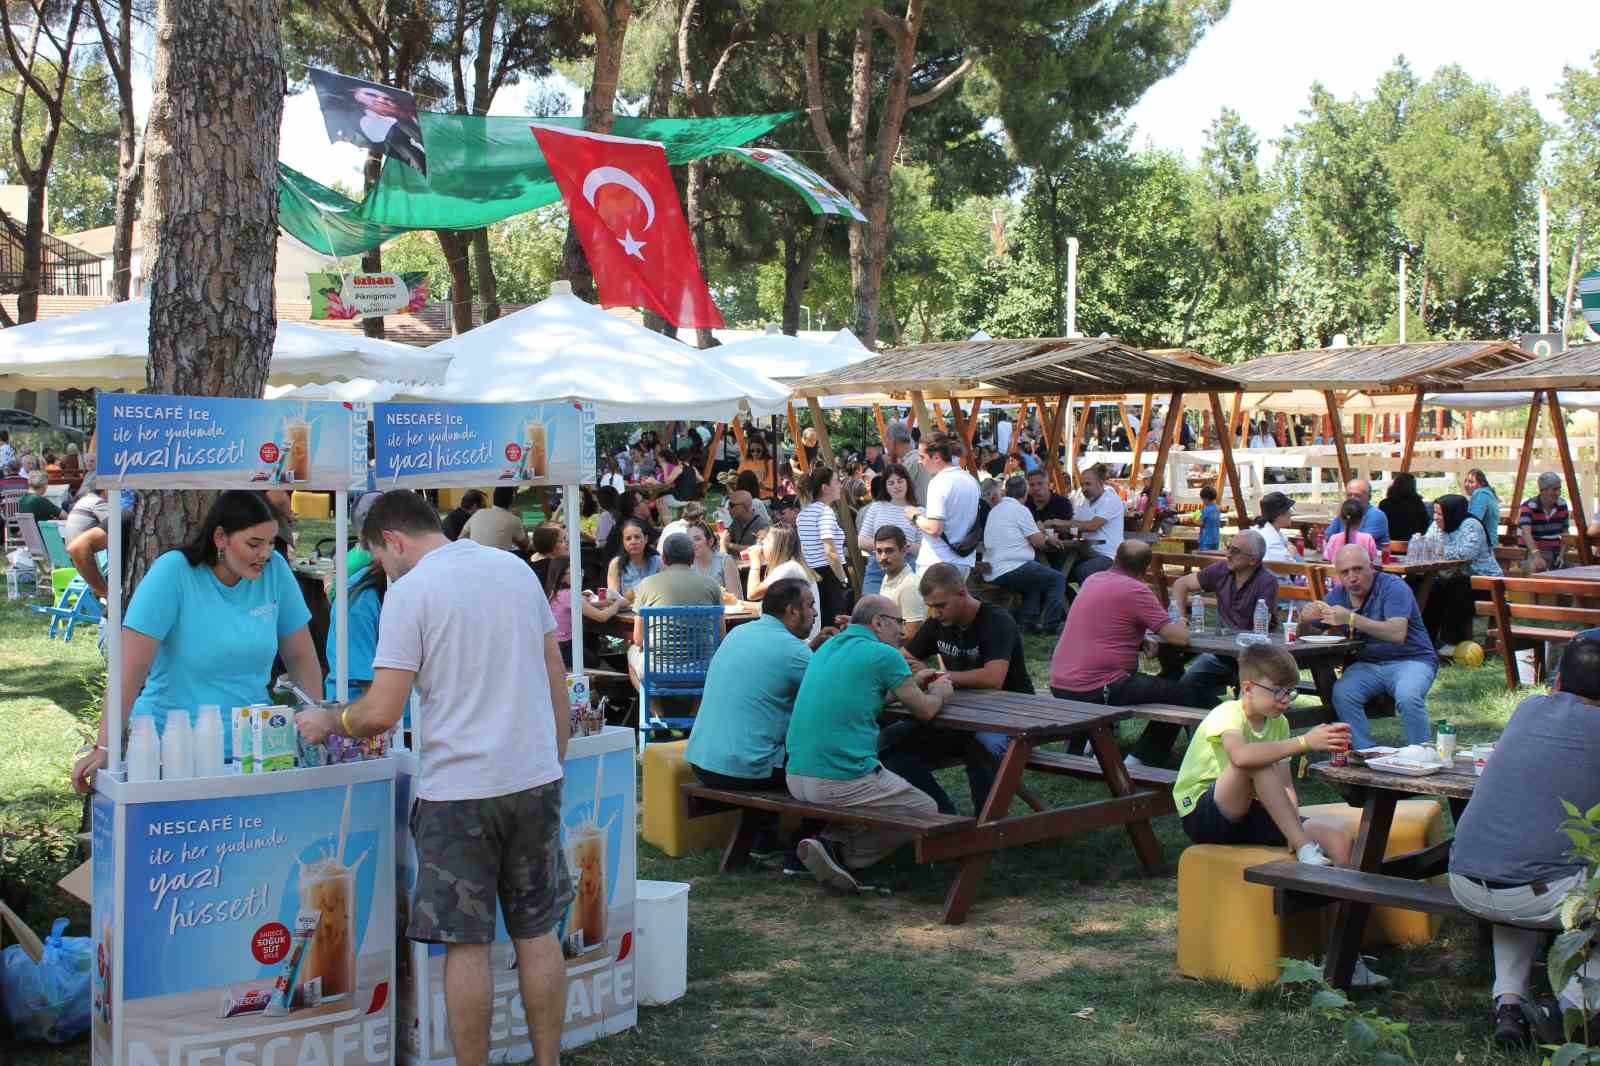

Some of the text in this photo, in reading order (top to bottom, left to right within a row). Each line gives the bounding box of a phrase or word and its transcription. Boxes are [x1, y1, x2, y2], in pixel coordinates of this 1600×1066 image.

[113, 405, 210, 421] NESCAFÉ Ice
[387, 412, 464, 425] NESCAFÉ Ice
[113, 420, 225, 445] ile her yudumda
[386, 424, 478, 449] ile her yudumda
[173, 439, 245, 470] hisset!
[436, 439, 496, 472] hisset!
[149, 815, 263, 836] NESCAFÉ Ice
[150, 826, 288, 865] ile her yudumda
[169, 883, 269, 936] hisset!
